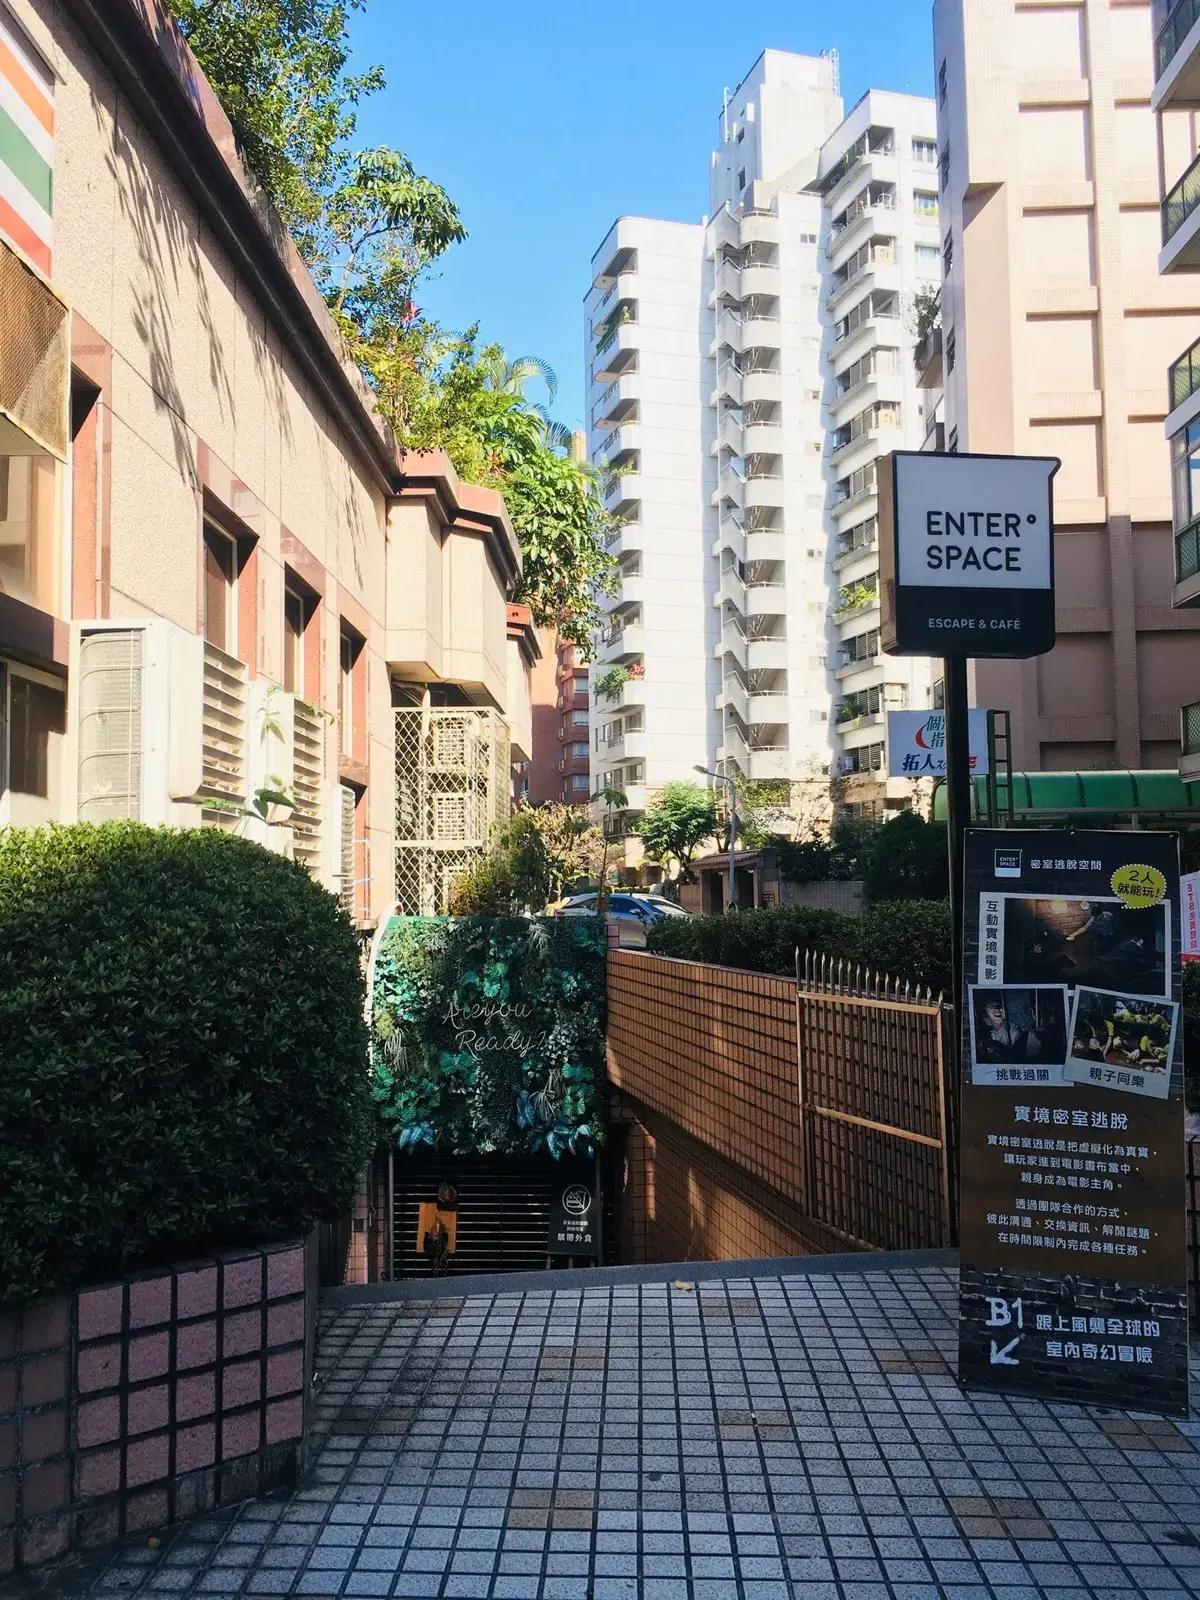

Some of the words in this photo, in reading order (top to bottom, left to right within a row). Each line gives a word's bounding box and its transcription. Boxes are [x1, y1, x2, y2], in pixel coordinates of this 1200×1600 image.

[926, 545, 1022, 572] SPACE
[928, 618, 975, 629] ESCAPE
[979, 619, 987, 629] &
[1030, 859, 1102, 871] 密室逃脫空間
[1128, 870, 1155, 885] 2人
[984, 900, 998, 980] 互動實境電影
[995, 1068, 1050, 1082] 挑戰過關
[1088, 1067, 1146, 1089] 親子同樂
[1014, 1105, 1129, 1131] 實境密室逃脫
[985, 1297, 1024, 1329] B1
[1046, 1341, 1153, 1363] 室內奇幻冒險
